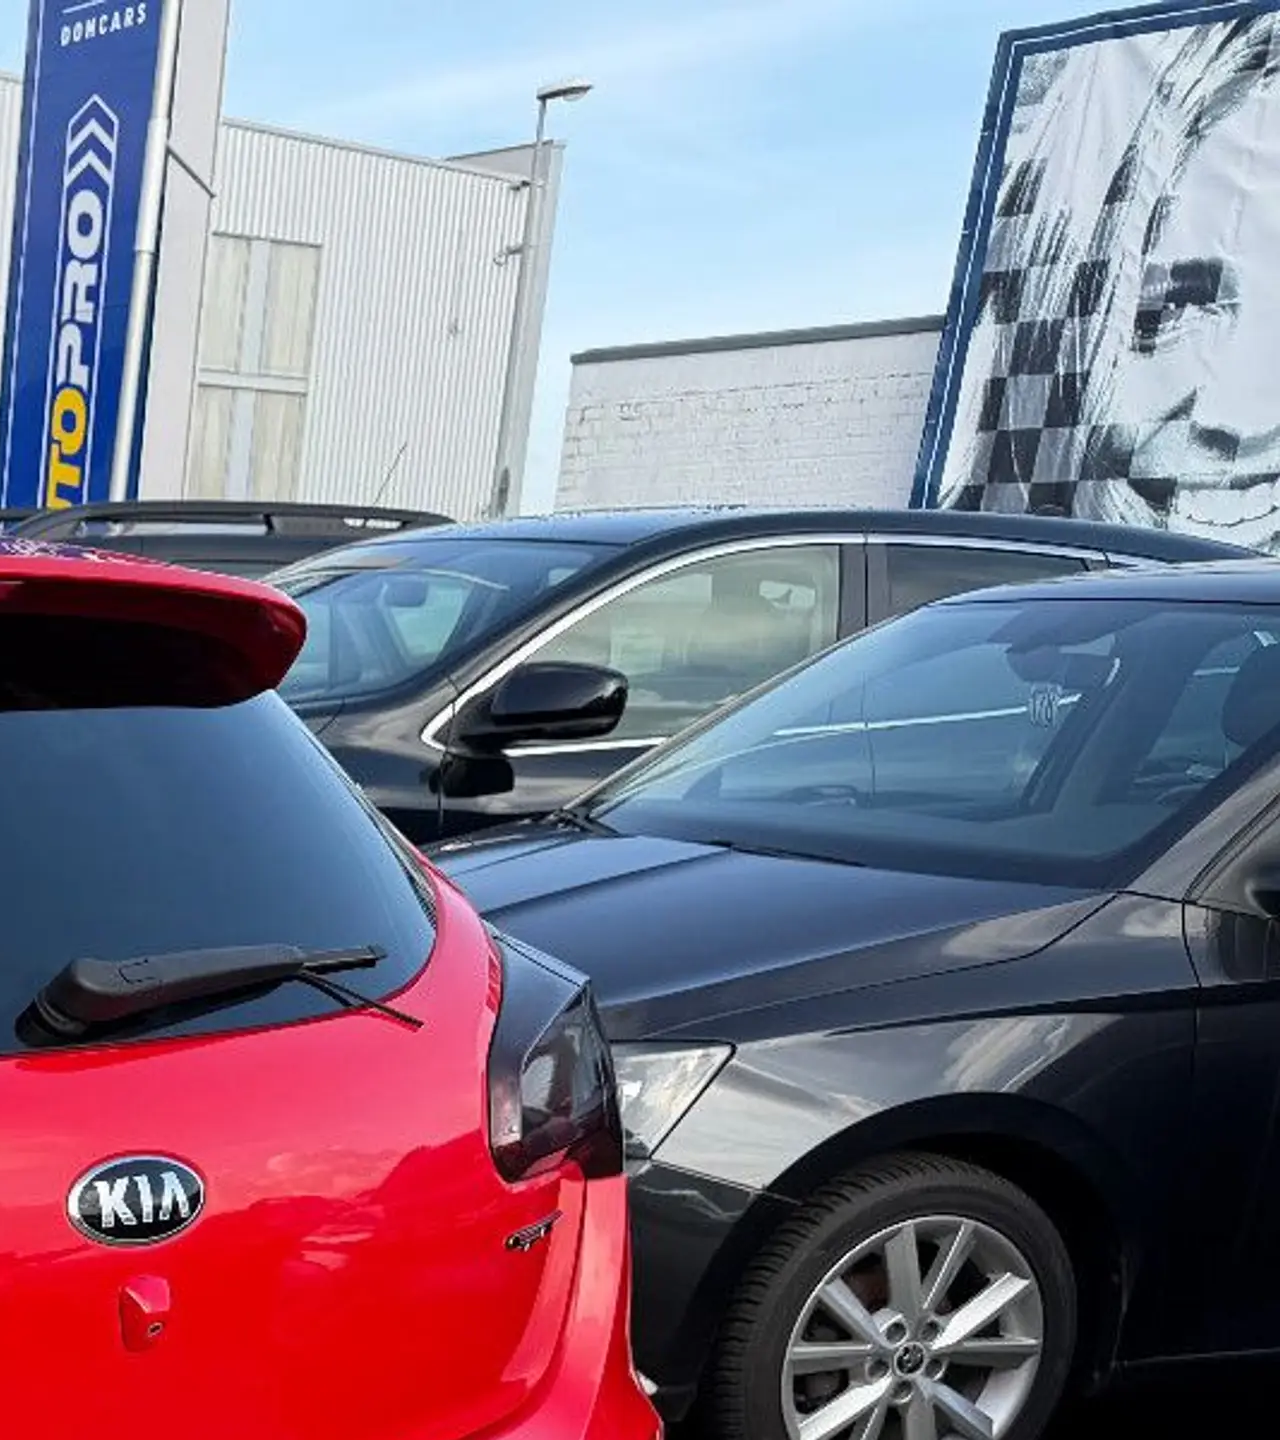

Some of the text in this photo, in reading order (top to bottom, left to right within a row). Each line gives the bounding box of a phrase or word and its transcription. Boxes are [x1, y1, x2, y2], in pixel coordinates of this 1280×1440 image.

[60, 3, 147, 47] DOMCARS
[46, 189, 103, 511] TOPRO
[92, 1170, 190, 1228] KIA
